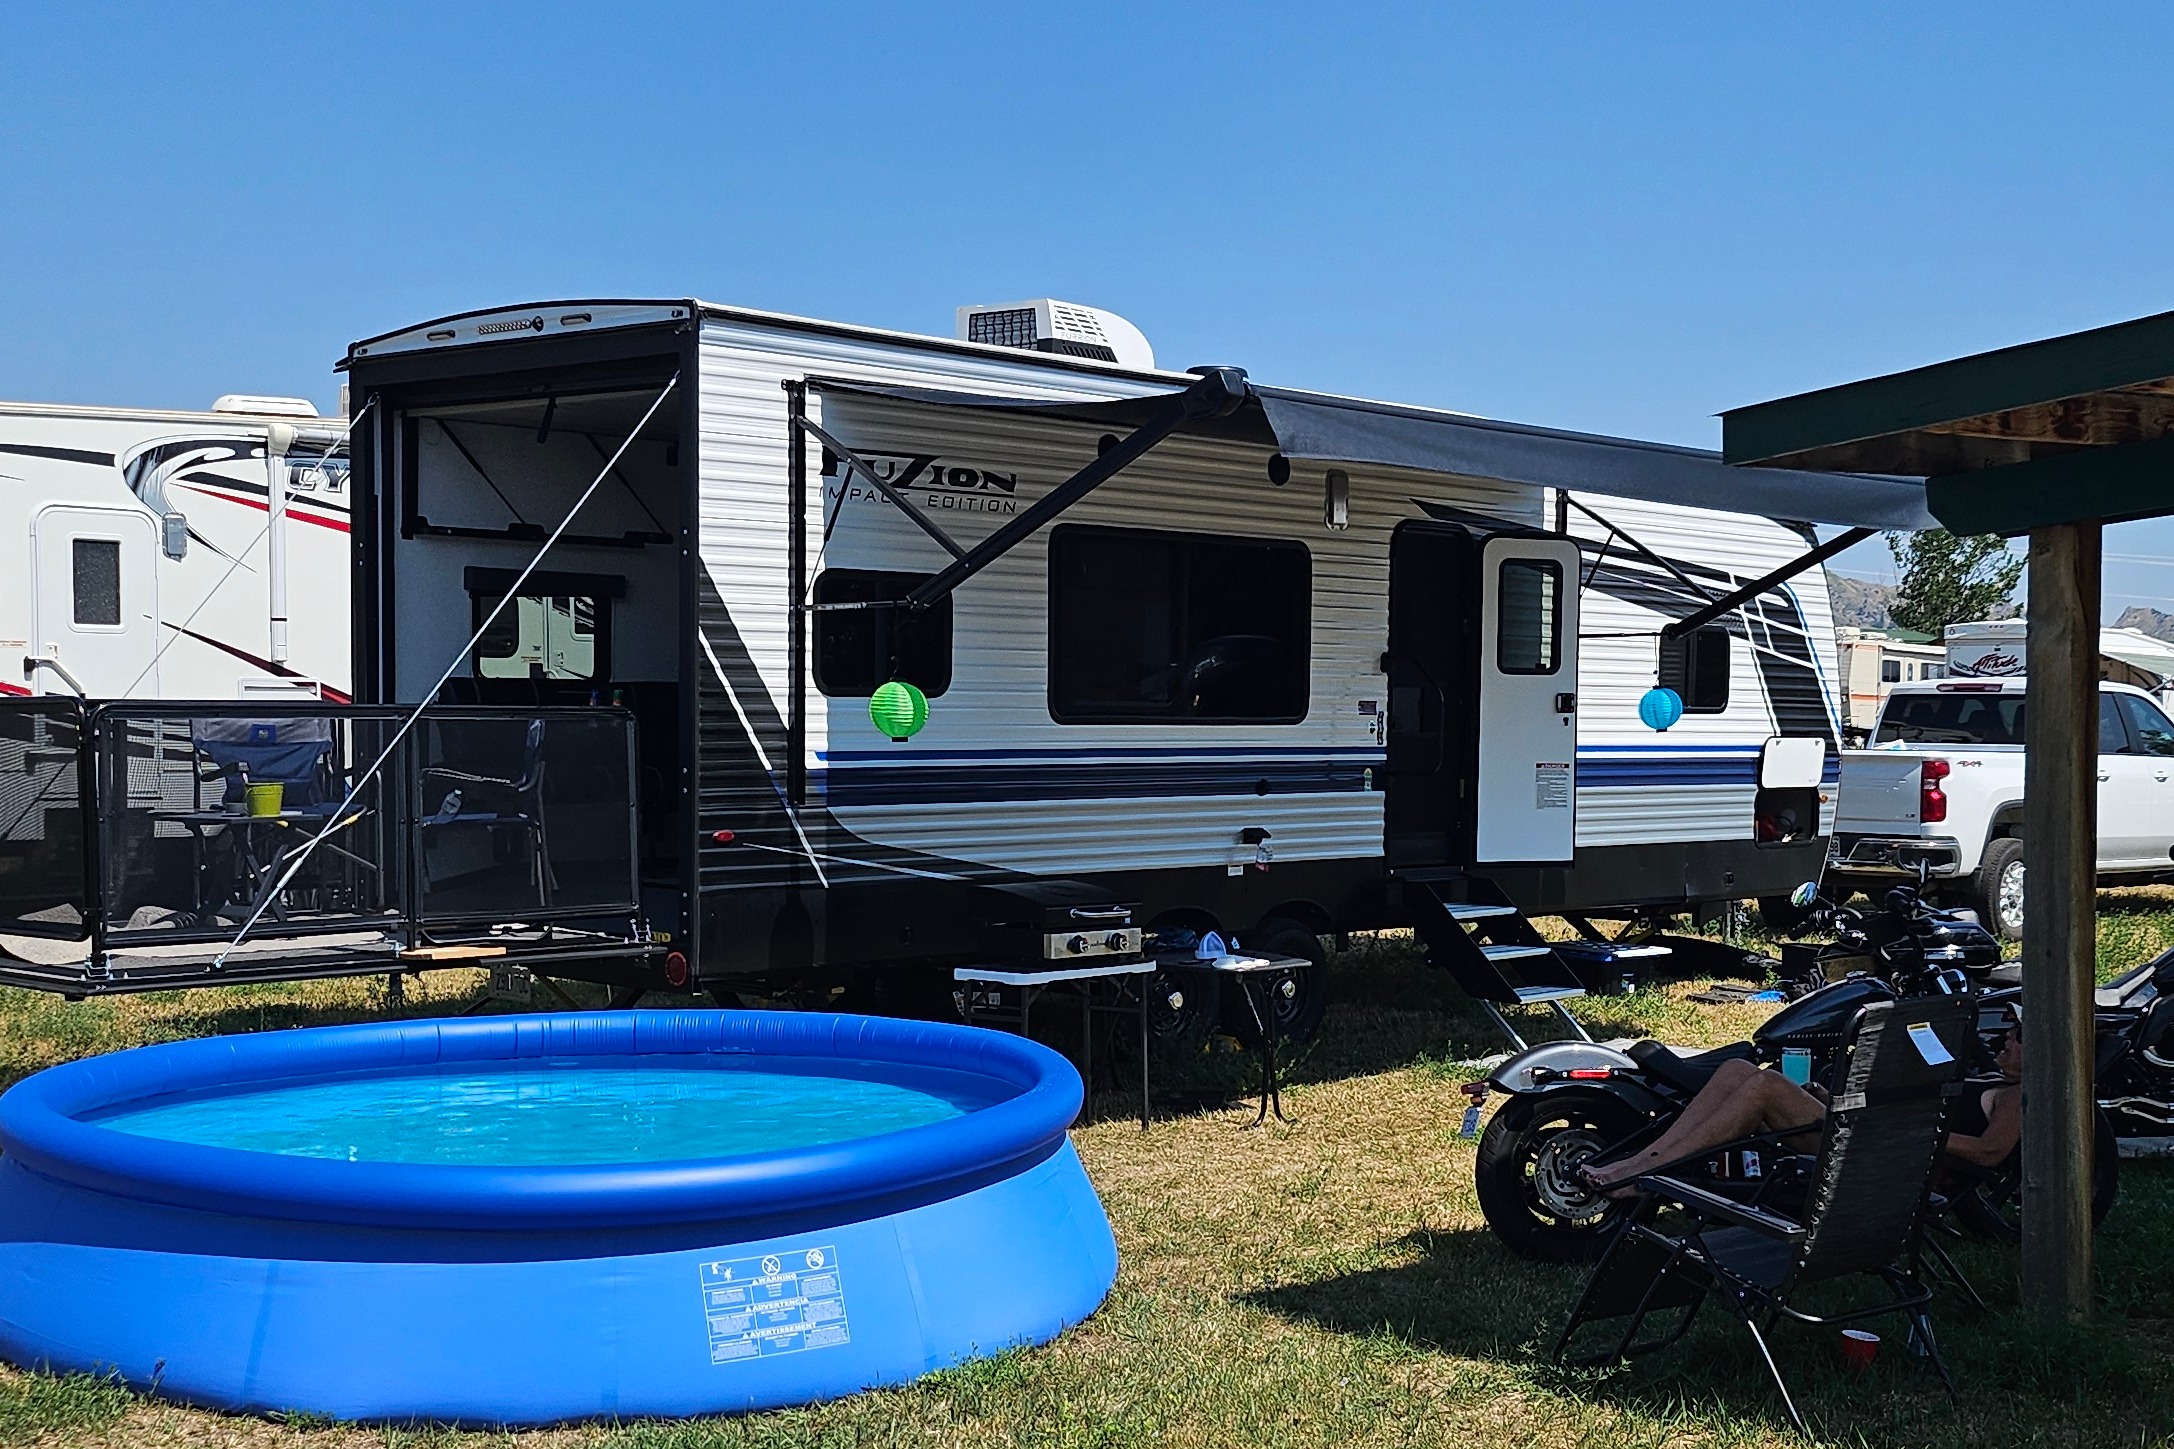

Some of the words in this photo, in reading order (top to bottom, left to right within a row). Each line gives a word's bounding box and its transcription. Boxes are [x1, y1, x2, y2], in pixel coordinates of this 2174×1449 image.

[927, 495, 1017, 514] EDITION
[758, 1273, 797, 1284] WARNING
[752, 1297, 809, 1311] ADVERTENCIA
